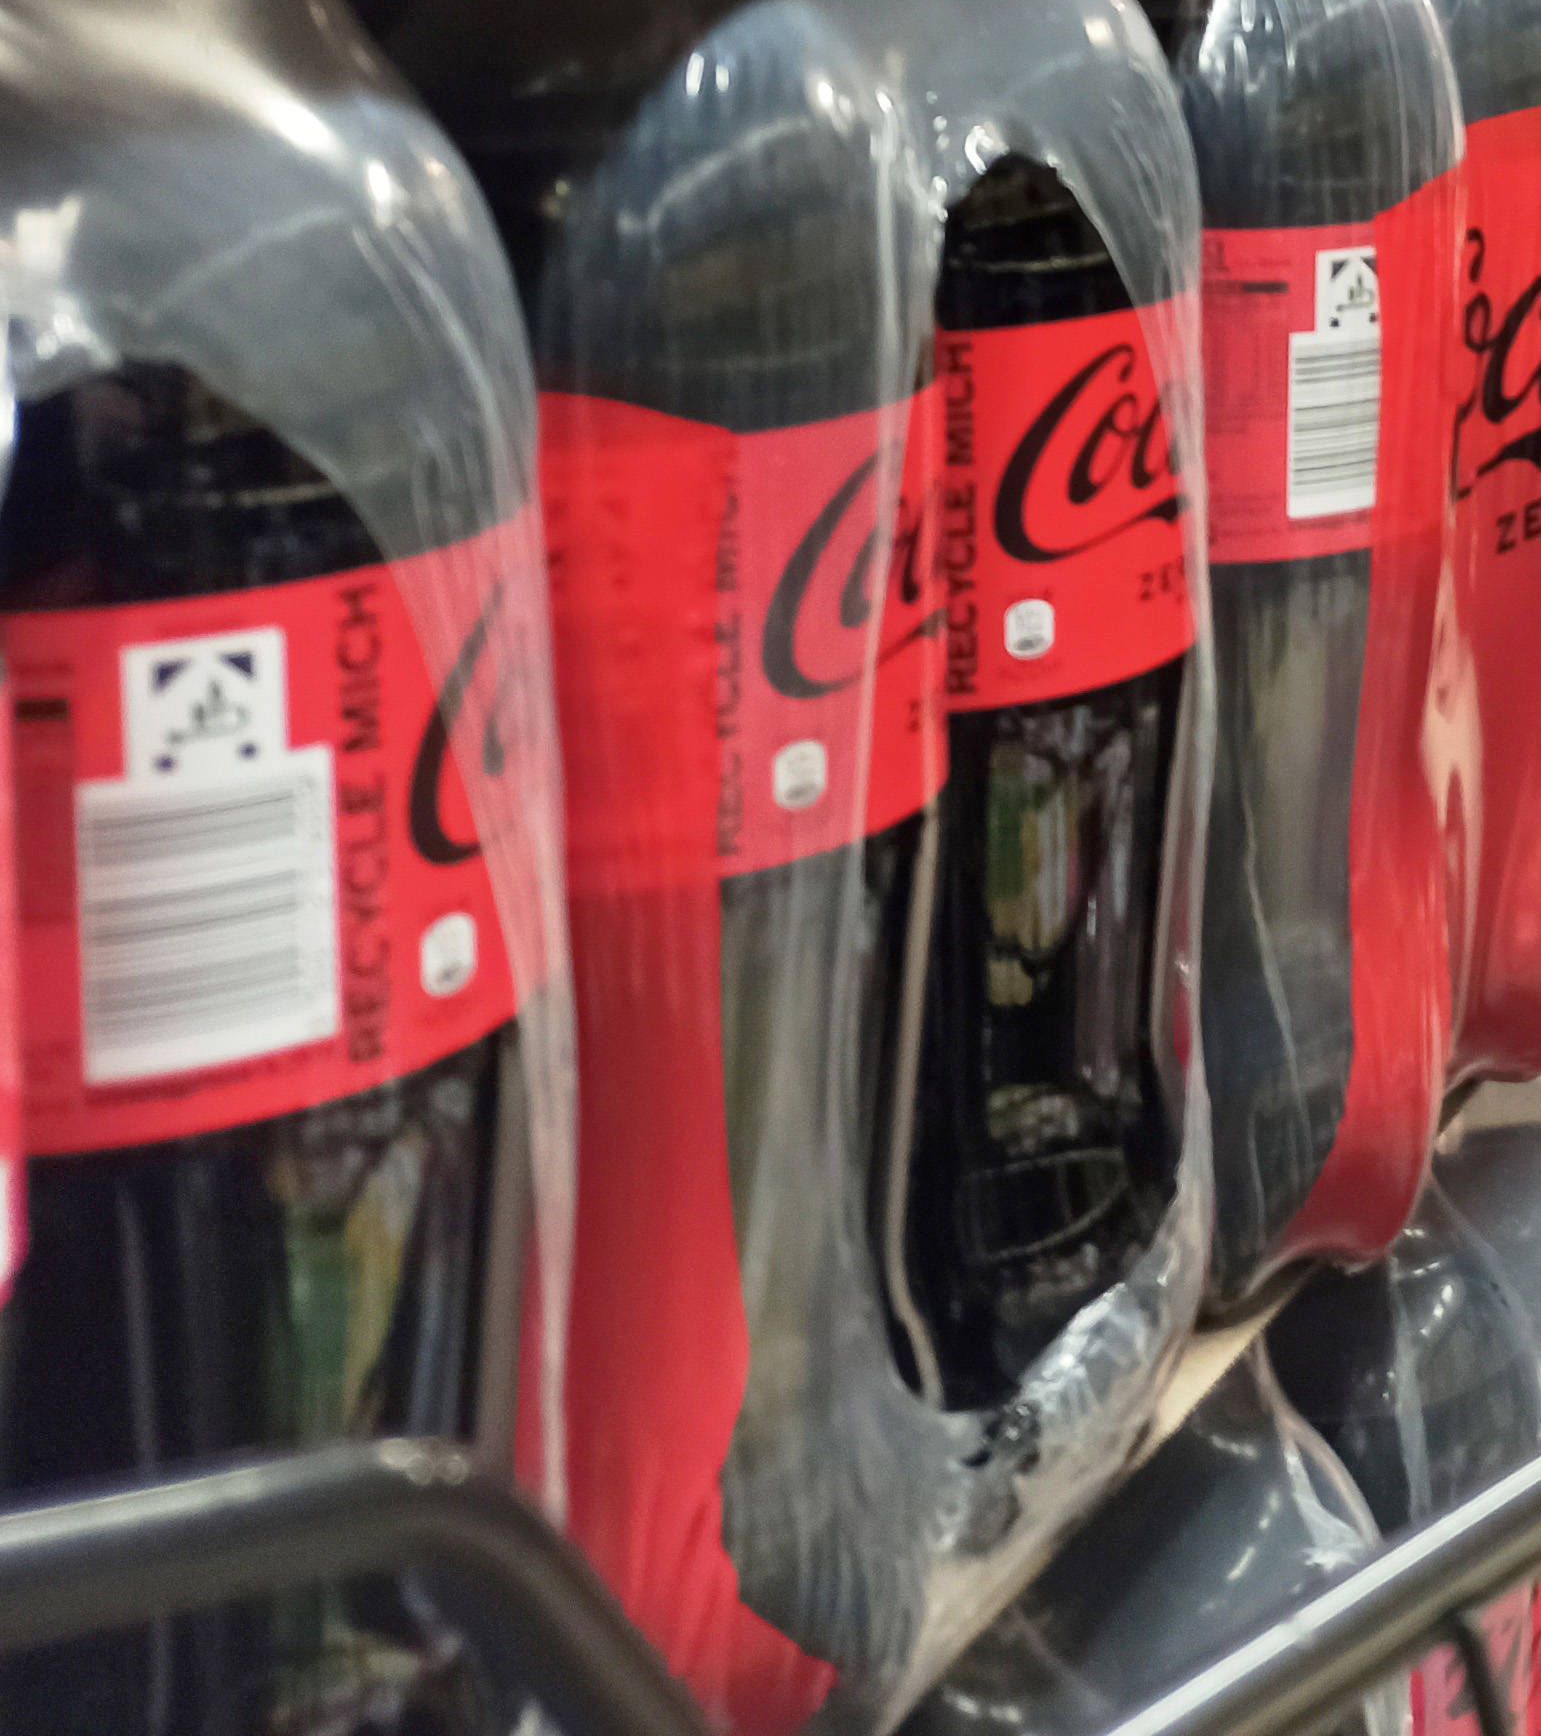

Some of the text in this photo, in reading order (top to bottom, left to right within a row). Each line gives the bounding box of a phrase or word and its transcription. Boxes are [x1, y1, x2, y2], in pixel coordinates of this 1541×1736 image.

[944, 338, 977, 696] RECYCLE MICH
[337, 581, 391, 1066] RECYCLE MICH
